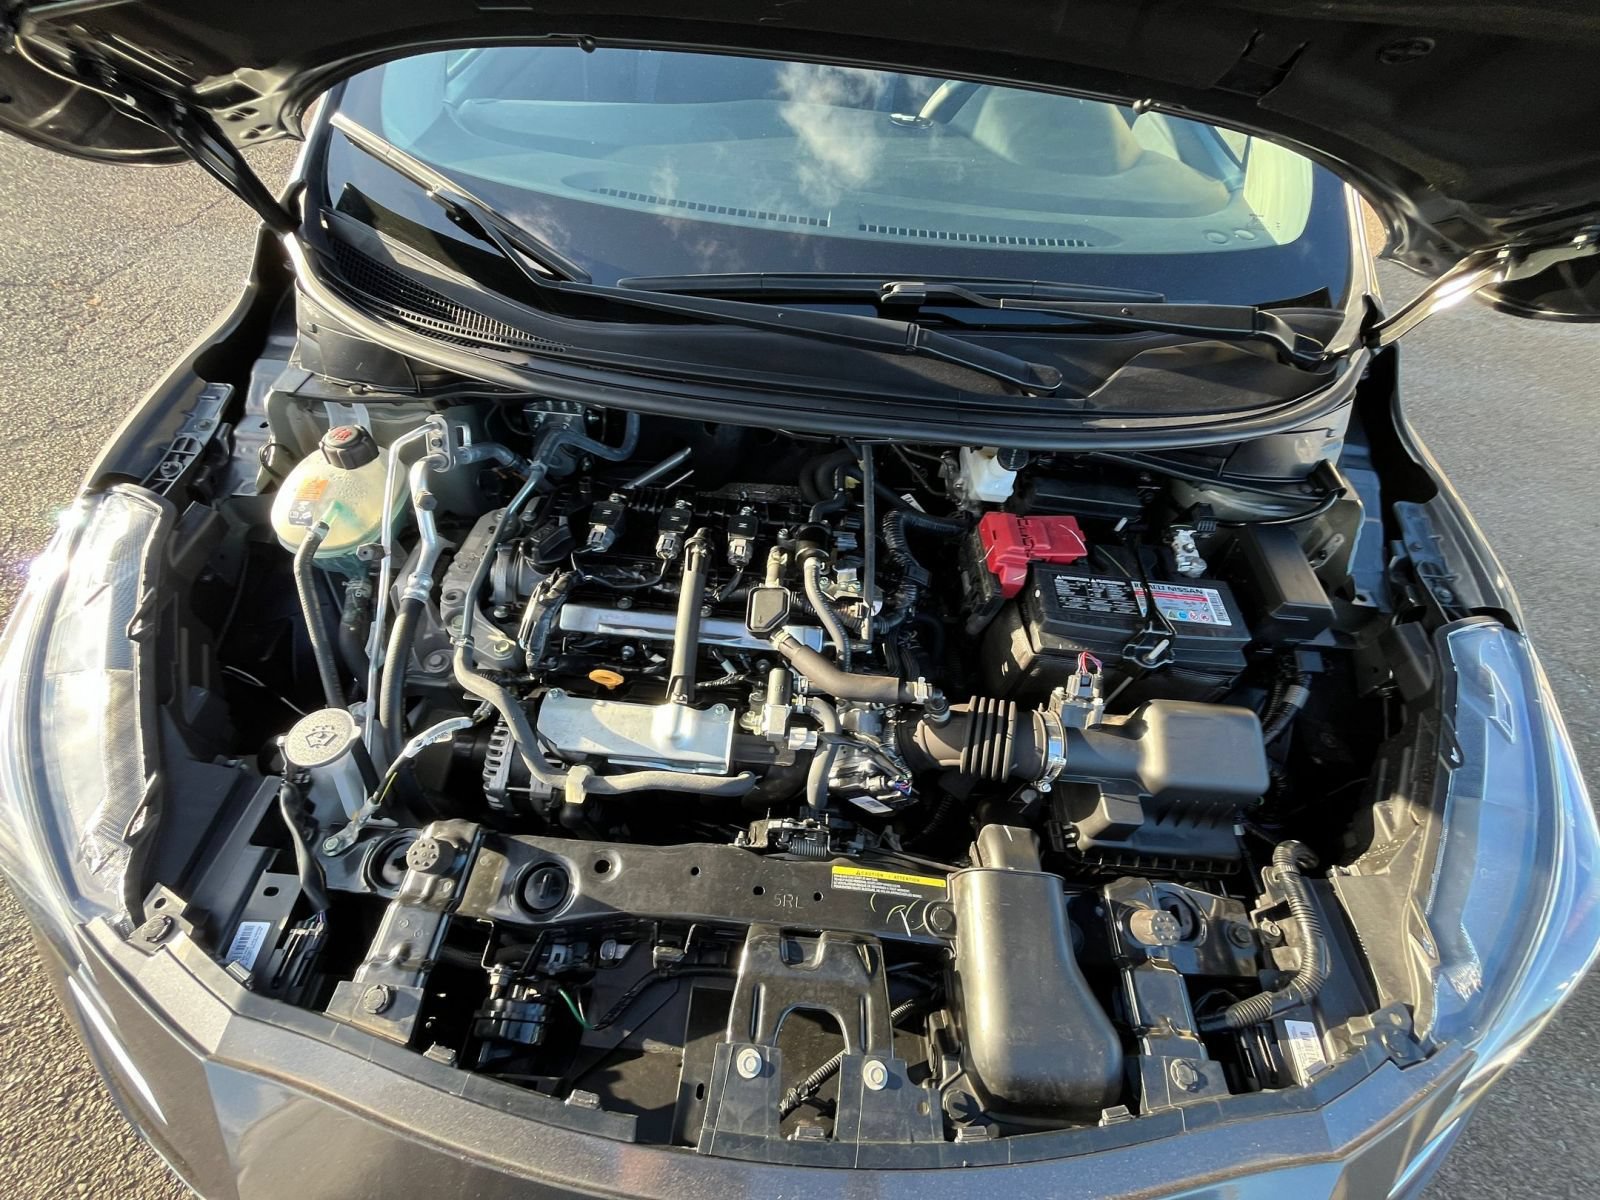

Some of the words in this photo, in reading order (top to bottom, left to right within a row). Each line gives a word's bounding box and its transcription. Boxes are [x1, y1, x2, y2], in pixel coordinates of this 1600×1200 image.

[1167, 586, 1204, 595] NISSAN
[860, 870, 884, 878] CAUTION
[893, 875, 921, 883] ATTENTION
